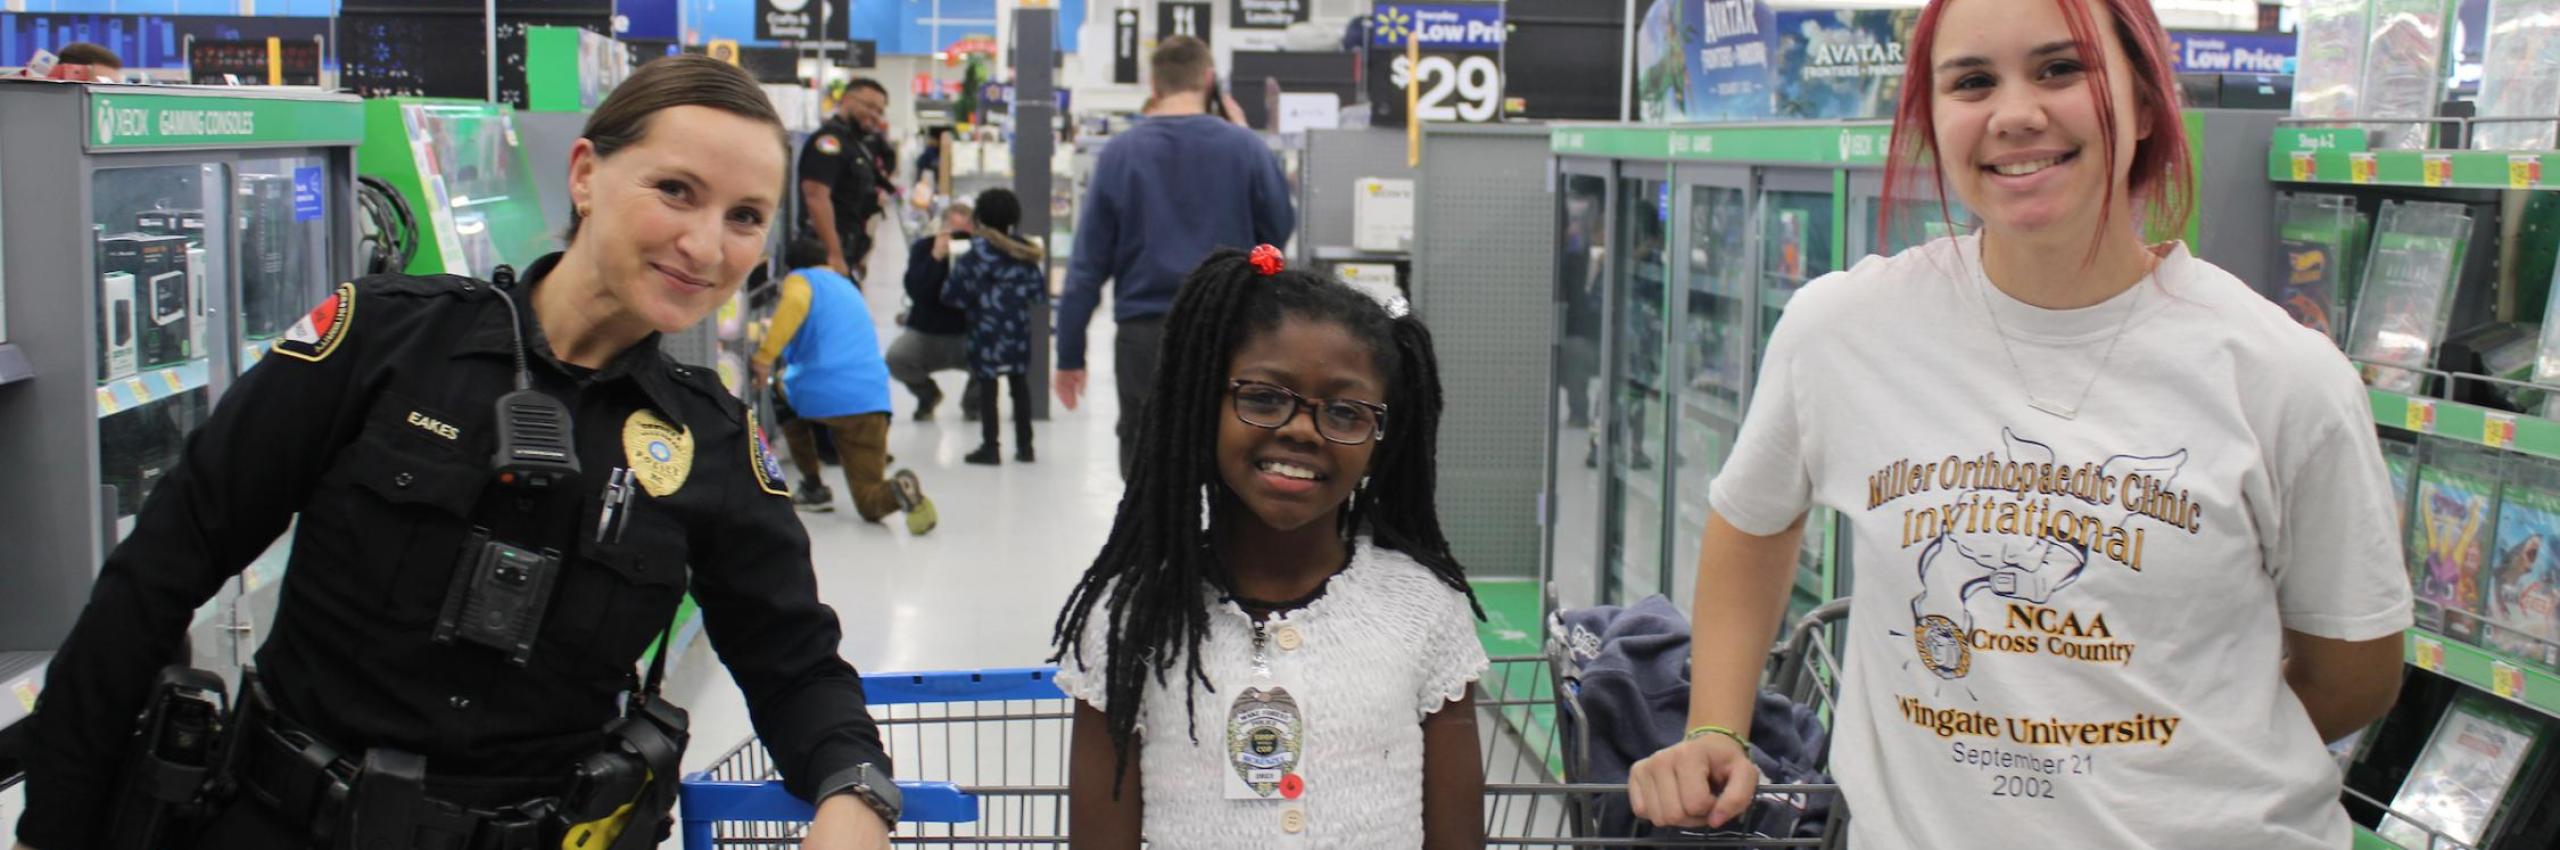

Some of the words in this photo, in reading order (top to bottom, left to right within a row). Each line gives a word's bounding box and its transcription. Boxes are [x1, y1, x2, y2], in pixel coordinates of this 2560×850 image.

[1416, 19, 1464, 42] Low
[1704, 0, 1759, 44] AVATAR
[1814, 41, 1905, 67] AVATAR
[2186, 47, 2230, 70] Low
[115, 109, 150, 136] XBOX
[159, 109, 204, 136] GAMING
[205, 110, 255, 135] CONSOLES
[2298, 133, 2318, 151] Shop
[406, 410, 461, 441] EAKES
[1866, 457, 1937, 511] Miller
[1938, 450, 2117, 506] Orthopaedic
[2119, 472, 2203, 535] Clinic
[1901, 493, 2146, 573] Invitational
[2006, 603, 2113, 639] NCAA
[1969, 628, 2040, 654] Cross
[2046, 635, 2136, 667] Country
[1894, 694, 2001, 739] Wingate
[2005, 713, 2182, 747] University
[1951, 741, 2065, 776] September
[2071, 753, 2095, 775] 21
[1991, 774, 2056, 800] 2002
